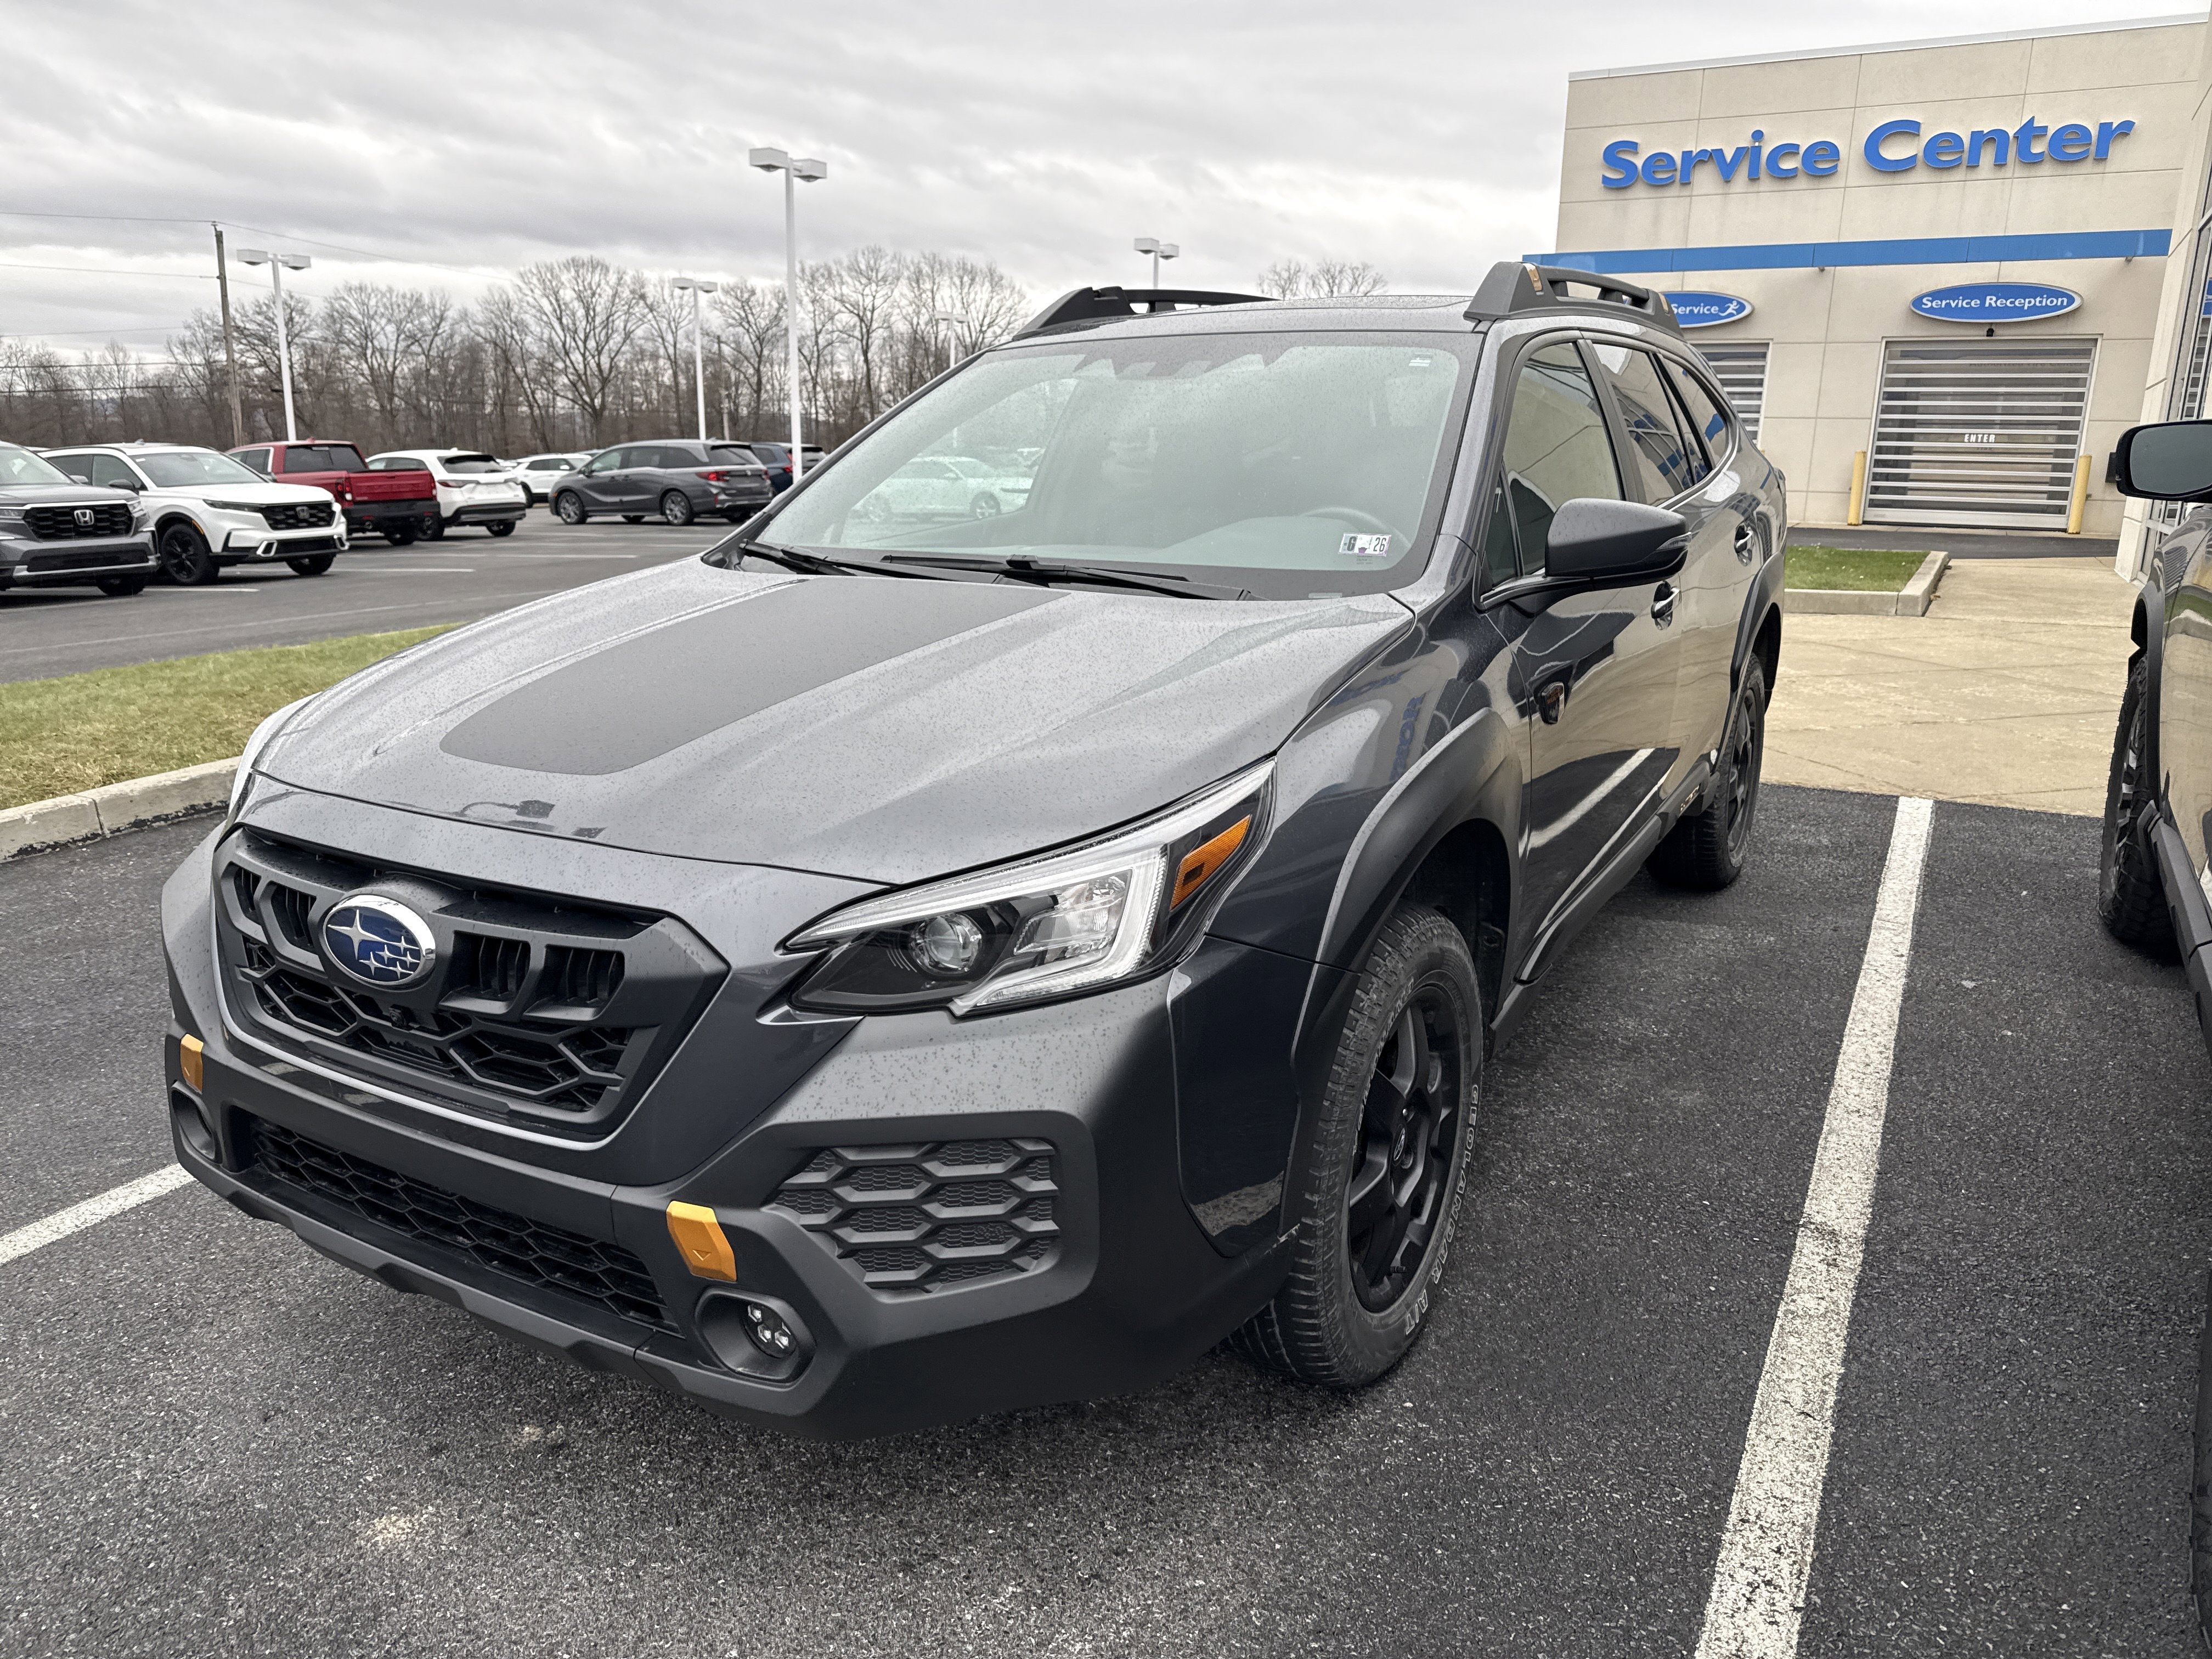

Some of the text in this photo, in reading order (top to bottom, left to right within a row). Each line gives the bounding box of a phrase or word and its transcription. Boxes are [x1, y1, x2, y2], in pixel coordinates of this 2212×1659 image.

[1601, 116, 2136, 188] Service Center
[1671, 303, 1719, 314] Service
[1922, 294, 2068, 310] Service Reception
[1964, 434, 1995, 443] ENTER
[1373, 537, 1386, 552] 26
[1405, 1085, 1478, 1335] GEOLANDAR A/T
